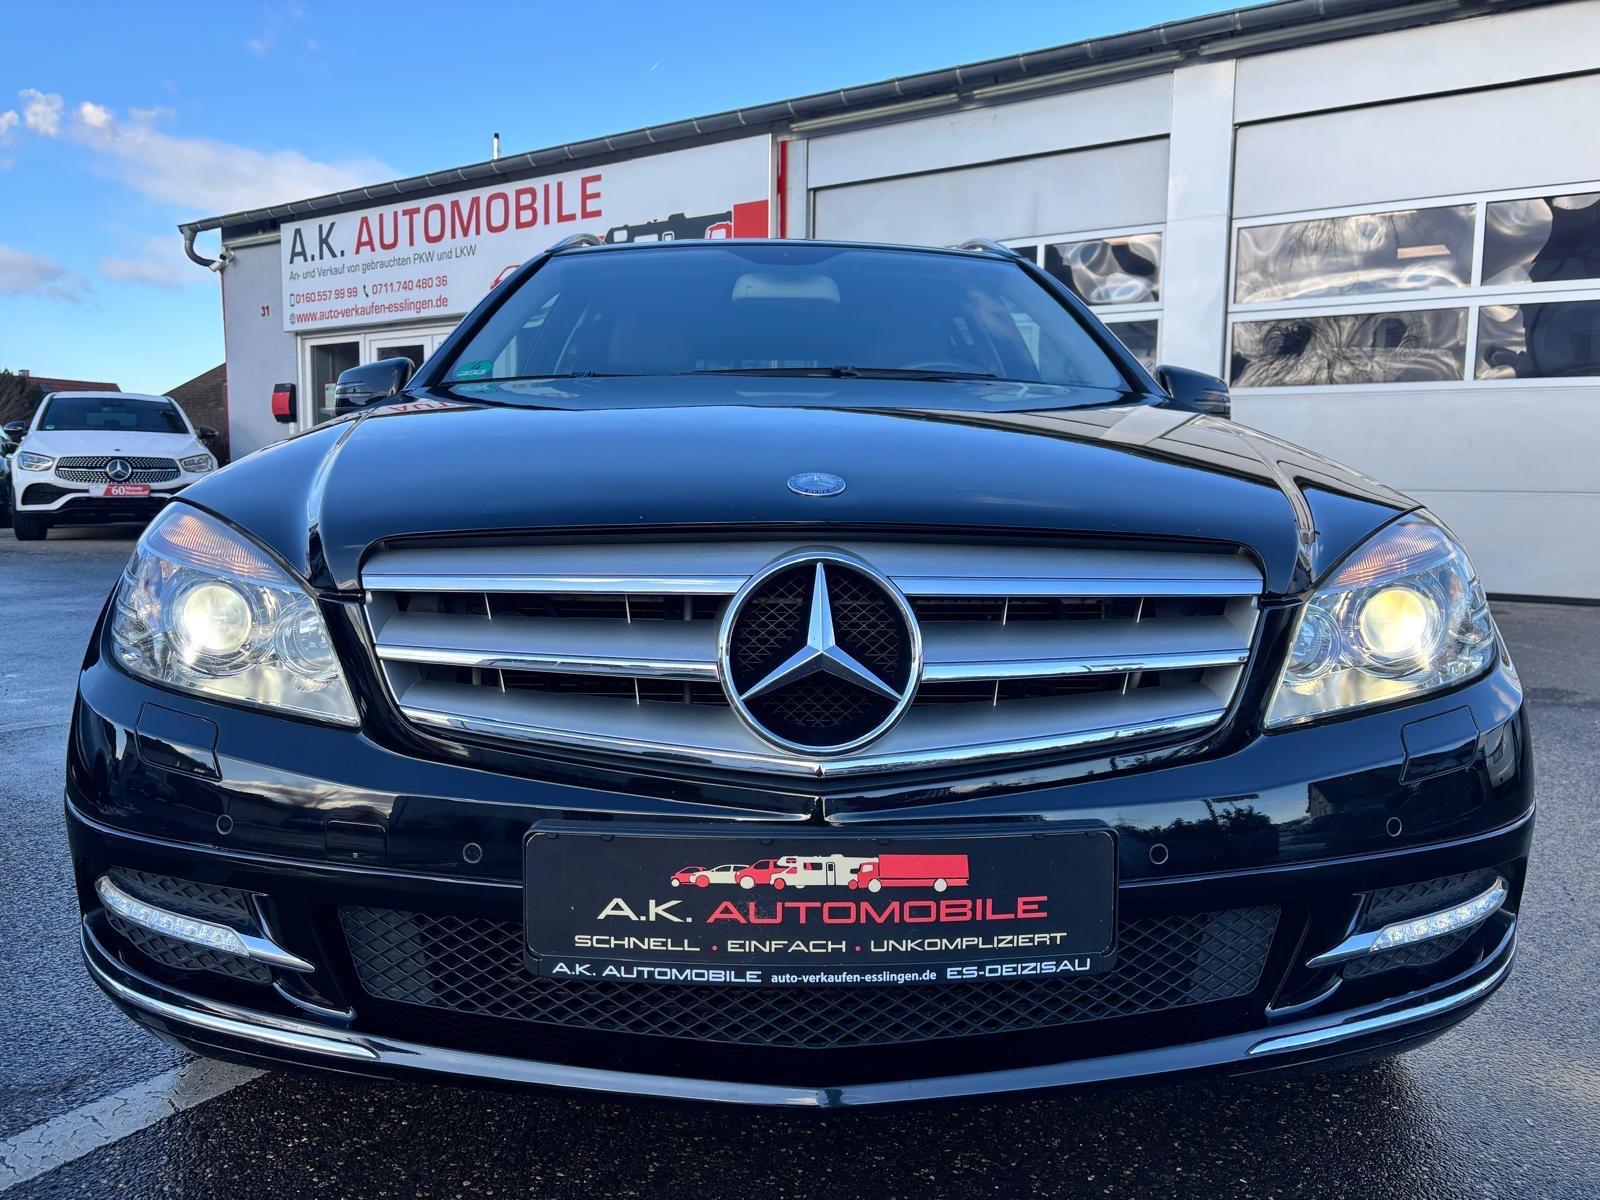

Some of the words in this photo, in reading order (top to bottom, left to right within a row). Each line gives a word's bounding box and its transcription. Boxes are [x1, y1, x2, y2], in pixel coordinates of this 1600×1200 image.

[289, 221, 345, 264] A.K.
[354, 173, 603, 255] AUTOMOBILE
[289, 271, 301, 281] An-
[302, 268, 316, 280] und
[317, 264, 345, 277] Verkauf
[346, 264, 360, 273] von
[361, 256, 412, 274] gebrauchten
[413, 251, 435, 264] PKW
[437, 250, 453, 261] und
[455, 245, 477, 258] LKW
[295, 290, 333, 303] 0160.557
[334, 288, 345, 299] 99
[347, 287, 358, 298] 99
[372, 280, 414, 295] 0711.740
[416, 277, 433, 290] 480
[436, 275, 448, 287] 36
[260, 305, 270, 317] 31
[296, 295, 448, 323] www.auto-verkaufen-esslingen.de
[111, 485, 126, 496] 60
[596, 897, 693, 922] A.K.
[706, 895, 1048, 925] AUTOMOBILE
[574, 934, 701, 952] SCHNELL
[727, 940, 846, 953] EINFACH
[870, 932, 1067, 952] UNKOMPLIZIERT
[552, 962, 597, 977] A.K.
[602, 965, 762, 983] AUTOMOBILE
[771, 969, 937, 984] auto-verkaufen-esslingen.de
[946, 958, 1091, 980] ES-DEIZISAU
